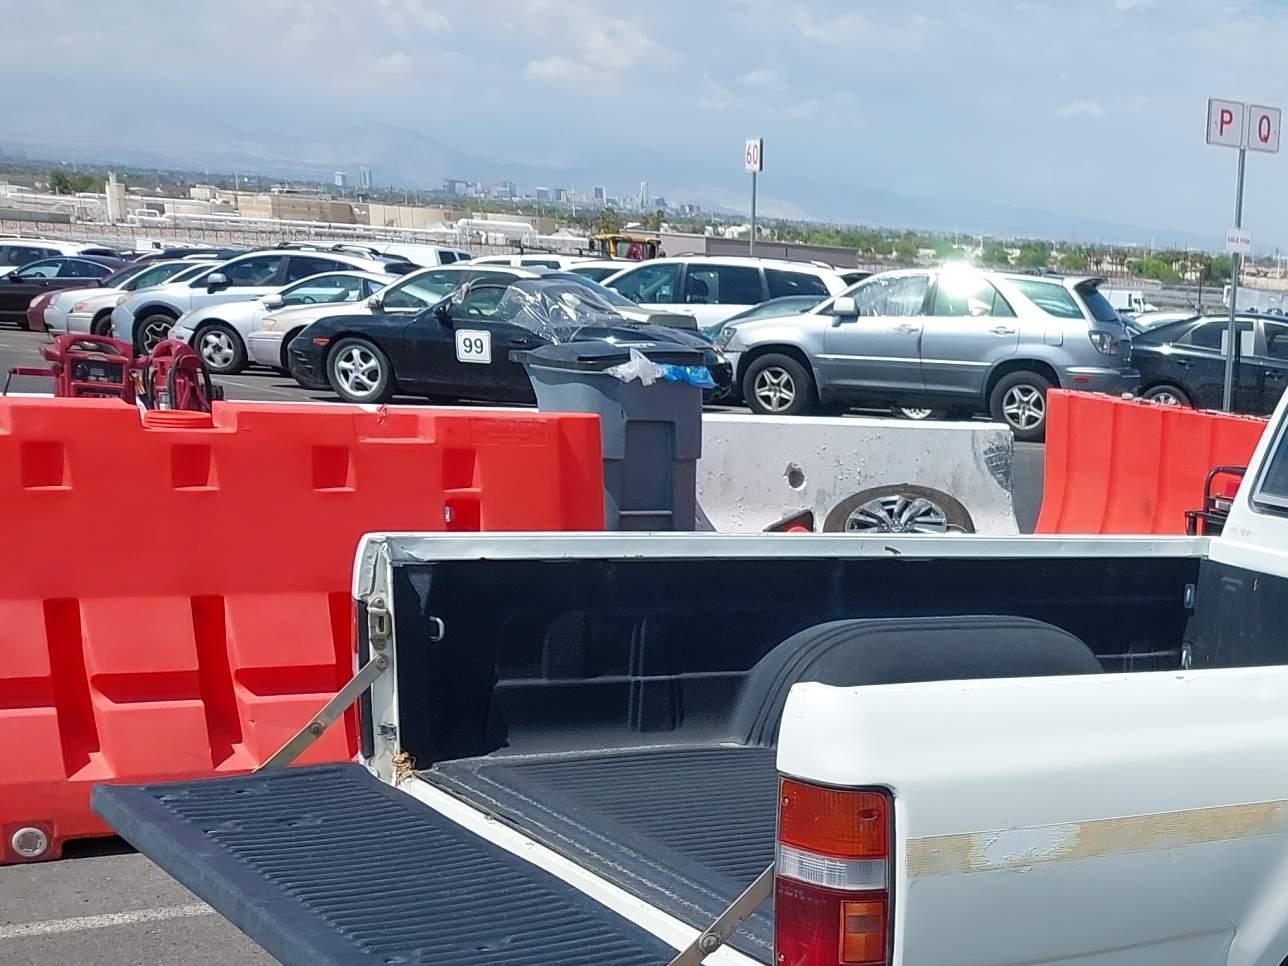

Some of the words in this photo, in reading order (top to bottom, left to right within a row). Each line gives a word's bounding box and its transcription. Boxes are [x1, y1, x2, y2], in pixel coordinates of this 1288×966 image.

[1219, 108, 1233, 137] P
[1258, 114, 1271, 144] Q
[746, 143, 759, 165] 60
[462, 337, 484, 354] 99
